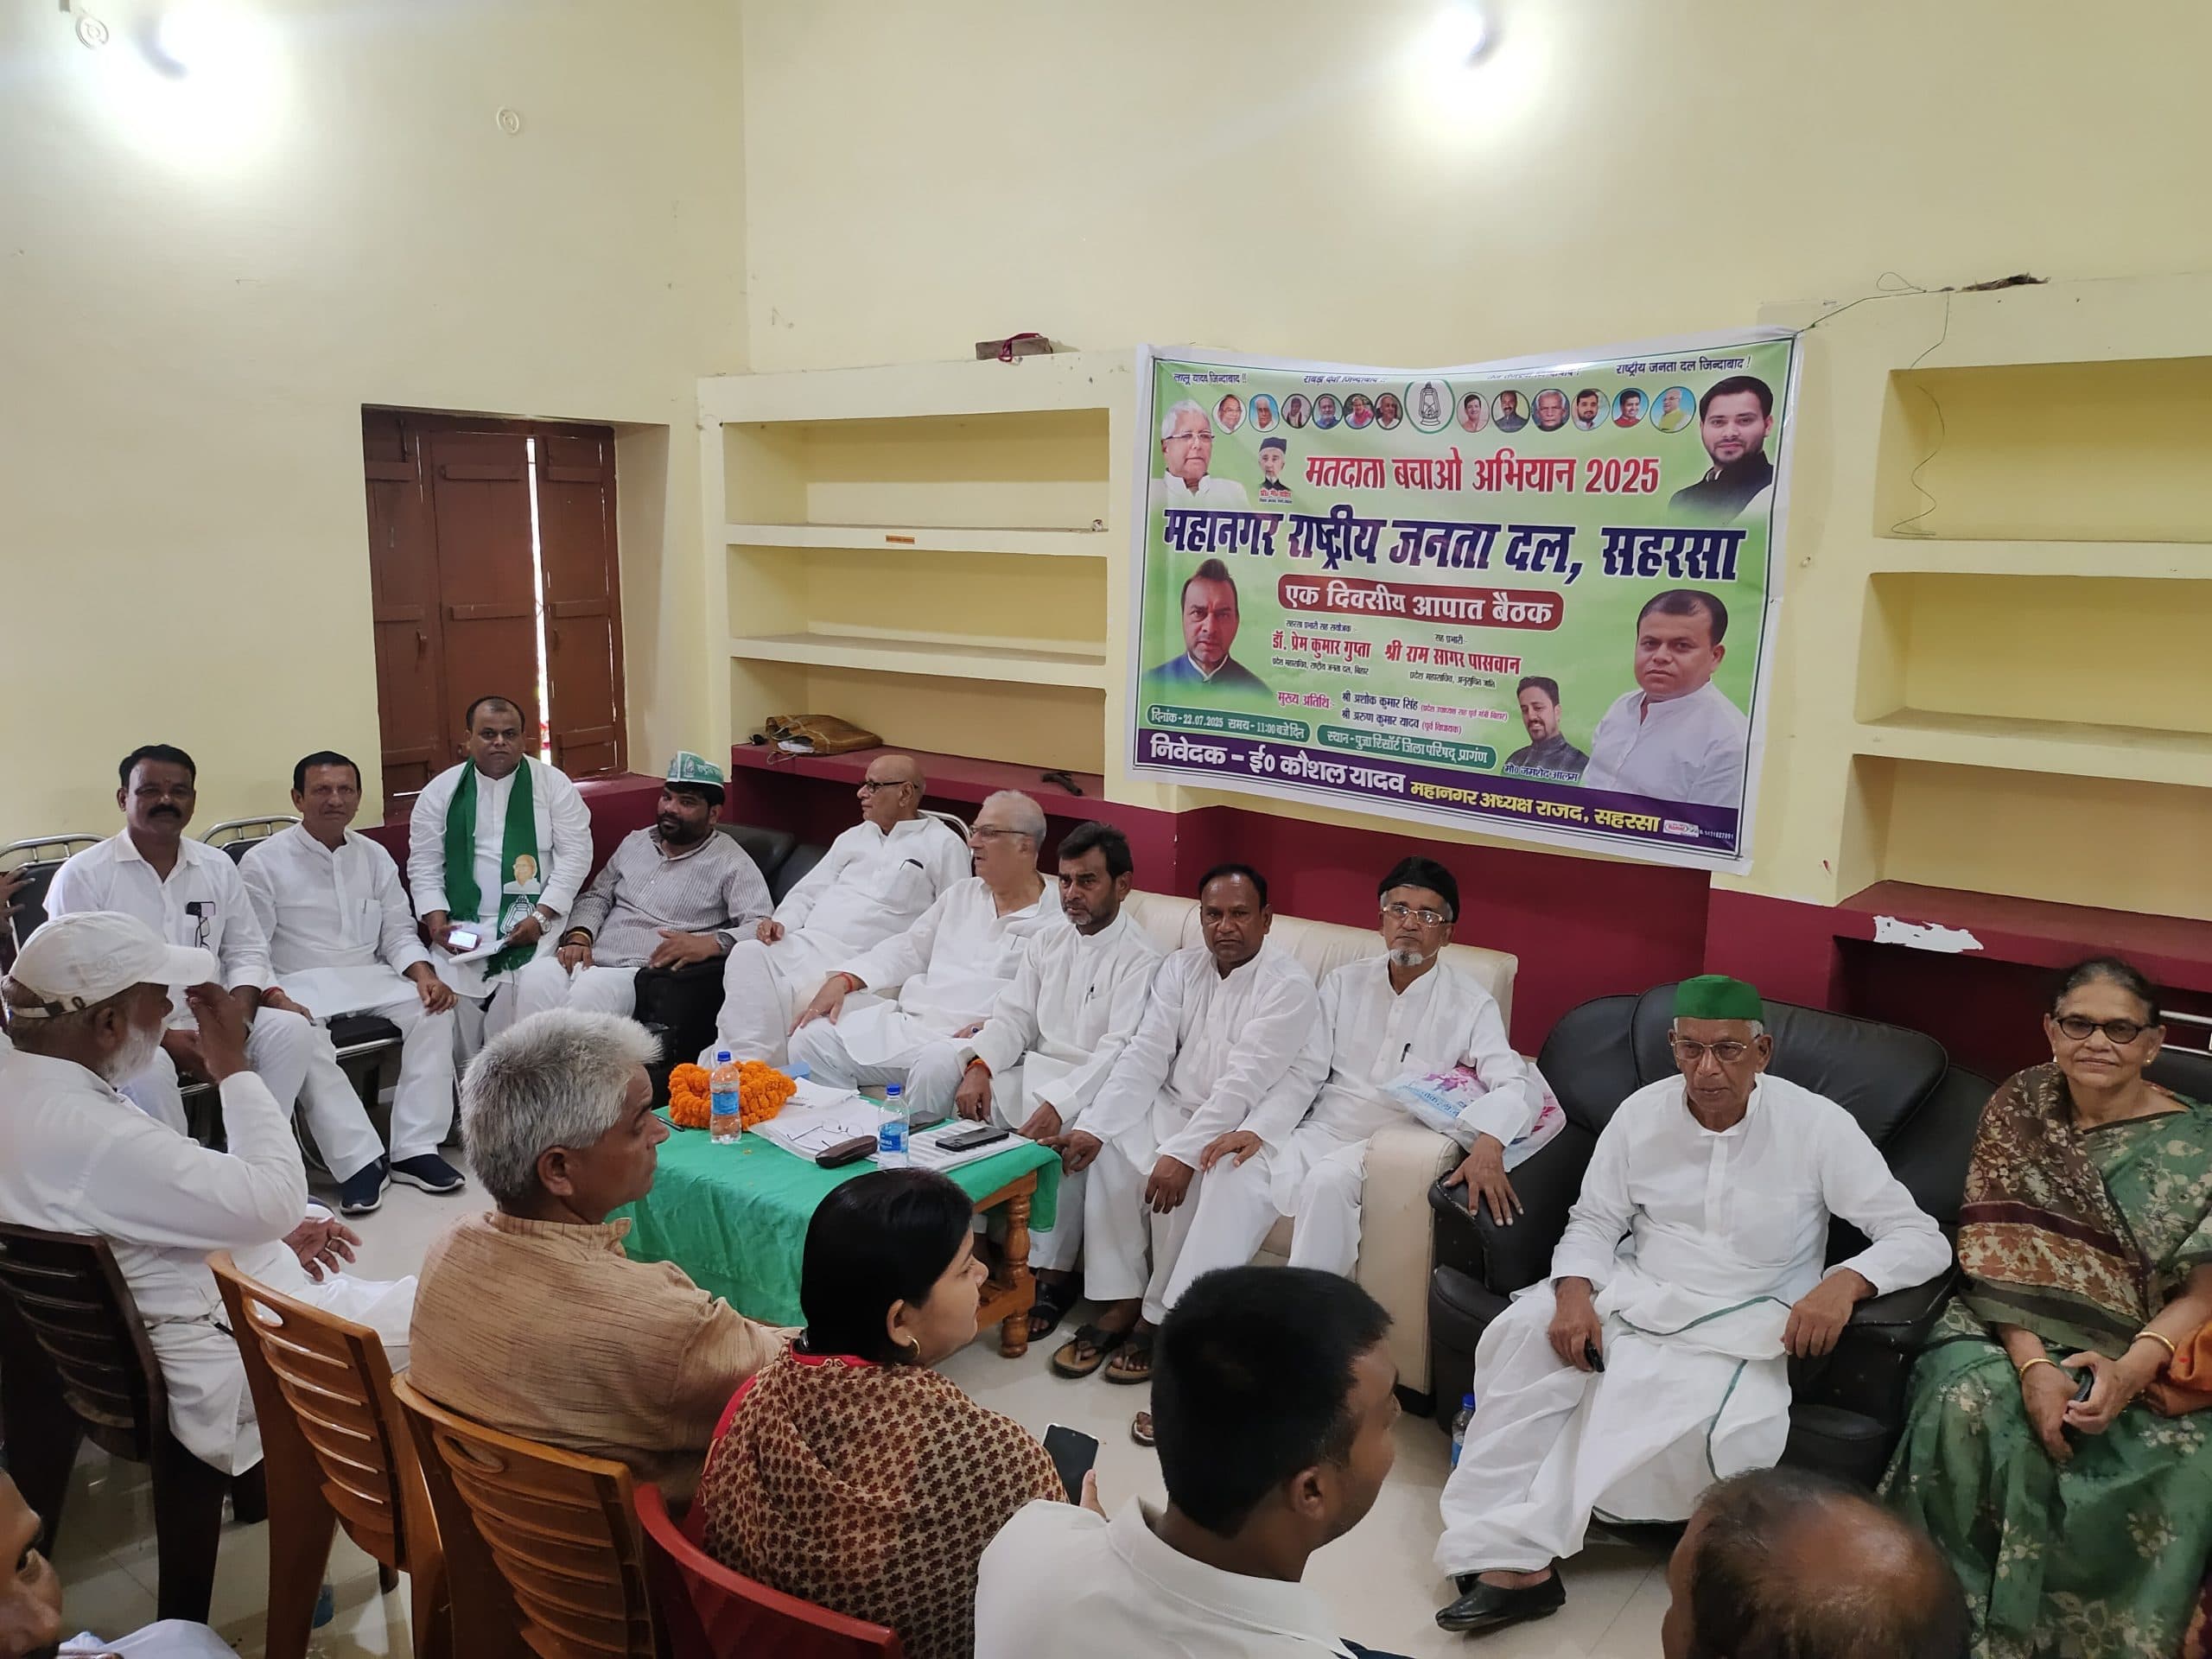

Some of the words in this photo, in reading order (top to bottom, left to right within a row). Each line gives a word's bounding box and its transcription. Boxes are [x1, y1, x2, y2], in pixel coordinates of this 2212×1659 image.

[1173, 373, 1191, 385] लालू
[1192, 374, 1208, 383] यादव
[1209, 371, 1241, 384] जिन्दाबाद
[1617, 359, 1646, 377] राष्ट्रीय
[1649, 362, 1677, 373] जनता
[1680, 362, 1696, 372] दल
[1699, 357, 1744, 372] जिन्दाबाद
[1306, 455, 1386, 490] मतदाता
[1392, 447, 1463, 492] बचाओ
[1472, 448, 1577, 493] अभियान
[1585, 458, 1660, 493] 2025
[1163, 509, 1284, 556] महानगर
[1287, 504, 1388, 570] राष्ट्रीय
[1389, 519, 1503, 570] जनता
[1504, 524, 1584, 585] दल,
[1601, 526, 1747, 582] सहरसा
[1285, 584, 1321, 607] एक
[1326, 580, 1407, 613] दिवसीय
[1412, 594, 1486, 621] आपात
[1491, 592, 1554, 624] बैठक
[1272, 630, 1287, 650] डॉ.
[1291, 631, 1309, 652] प्रेम
[1311, 638, 1342, 658] कुमार
[1344, 640, 1372, 662] गुप्ता
[1384, 639, 1402, 662] श्री
[1406, 645, 1430, 664] राम
[1433, 648, 1465, 668] सागर
[1468, 652, 1522, 675] पासवान
[1278, 690, 1300, 707] मुख्य
[1342, 689, 1351, 702] श्री
[1354, 691, 1377, 706] अशोक
[1379, 696, 1400, 710] कुमार
[1402, 696, 1419, 711] सिंह
[1341, 707, 1351, 720] श्री
[1353, 711, 1374, 723] अरुण
[1376, 714, 1397, 728] कुमार
[1400, 716, 1420, 729] यादव
[1372, 733, 1401, 751] रिसॉर्ट
[1402, 737, 1425, 755] जिला
[1150, 733, 1228, 765] निवेदक
[1280, 749, 1348, 785] कौशल
[1349, 766, 1406, 793] यादव
[1410, 781, 1478, 805] महानगर
[1478, 791, 1533, 814] अध्यक्ष
[1535, 799, 1590, 823] राजद,
[1594, 808, 1662, 832] सहरसा
[1551, 770, 1579, 782] आलम
